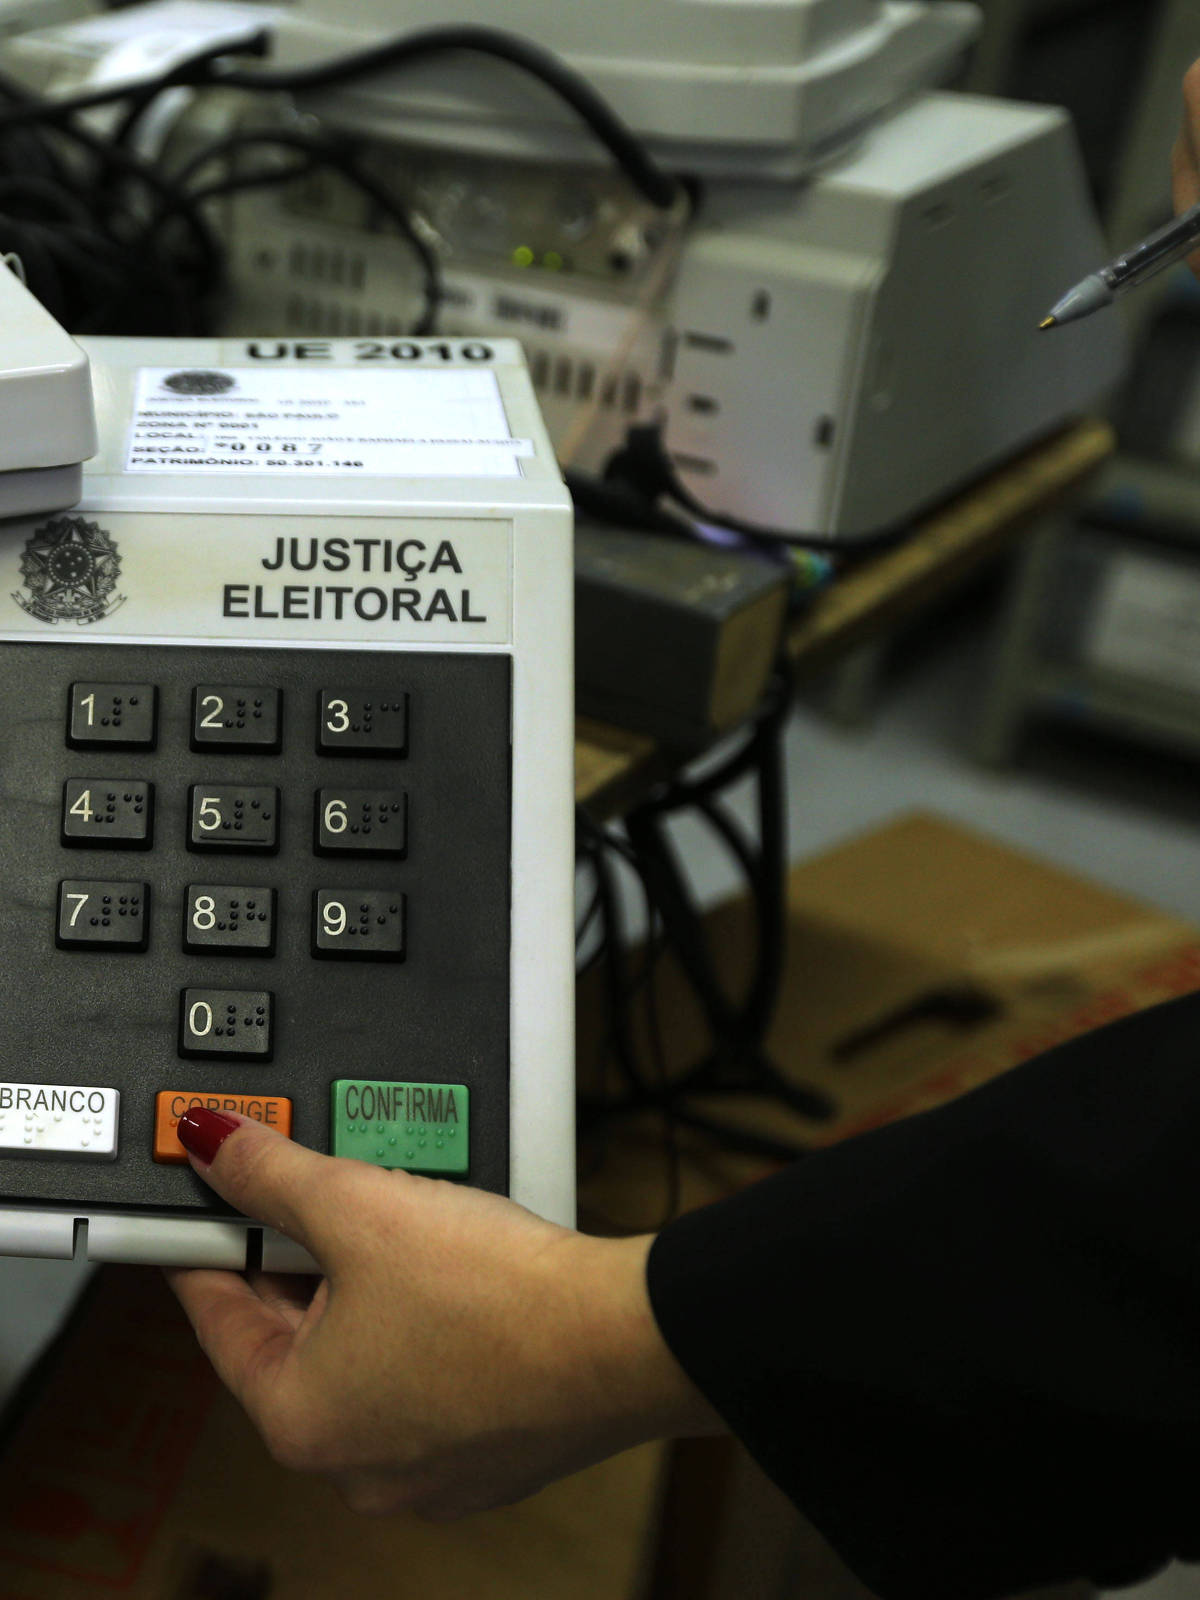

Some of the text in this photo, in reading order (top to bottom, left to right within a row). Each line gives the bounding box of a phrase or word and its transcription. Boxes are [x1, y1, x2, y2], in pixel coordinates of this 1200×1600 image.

[248, 343, 495, 361] UE 2010
[131, 457, 259, 466] PATRIMÔNIO:
[132, 445, 206, 453] SEÇÃO:
[261, 537, 464, 582] JUSTIÇA
[222, 584, 487, 623] ELEITORAL
[80, 693, 97, 726] 1
[199, 695, 224, 729] 2
[325, 699, 351, 733] 3
[69, 790, 94, 823] 4
[198, 798, 222, 831] 5
[323, 799, 348, 834] 6
[65, 893, 89, 927] 7
[192, 896, 217, 930] 8
[322, 901, 348, 935] 9
[188, 1002, 213, 1036] 0
[0, 1087, 106, 1115] BRANCO
[345, 1085, 459, 1125] CONFIRMA
